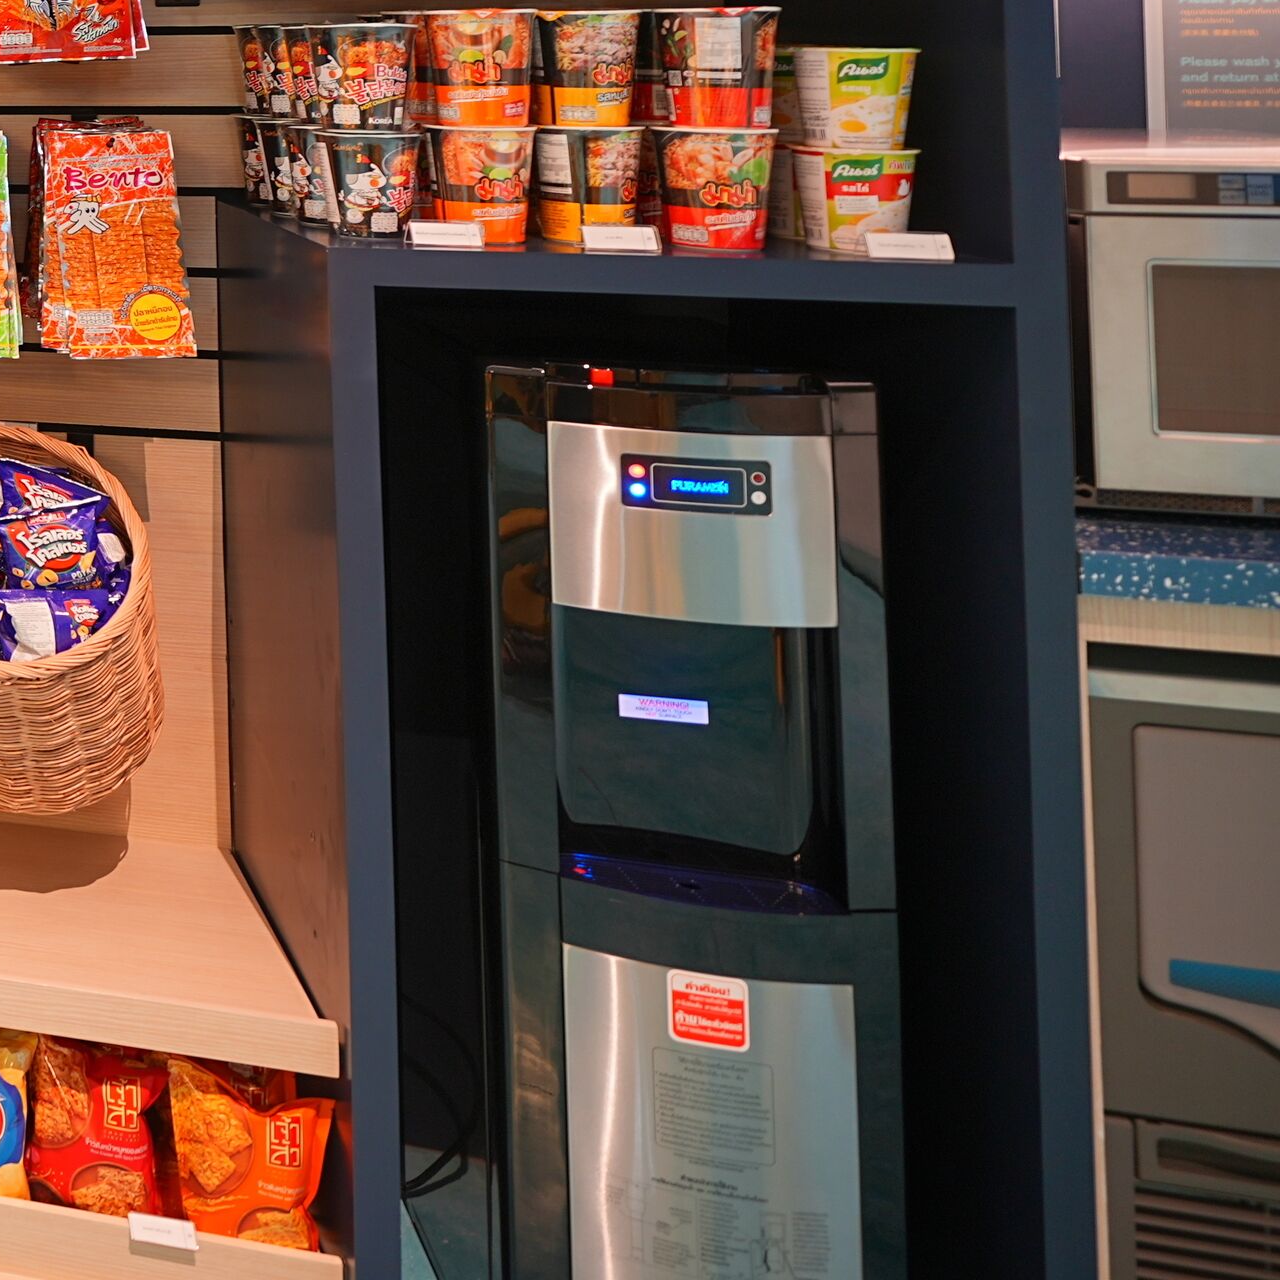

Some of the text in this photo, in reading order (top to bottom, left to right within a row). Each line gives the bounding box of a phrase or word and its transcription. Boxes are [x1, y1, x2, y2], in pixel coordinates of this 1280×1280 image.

[1181, 56, 1270, 67] Please wash
[1182, 72, 1209, 82] and
[1214, 73, 1259, 82] return
[62, 166, 166, 193] Bento
